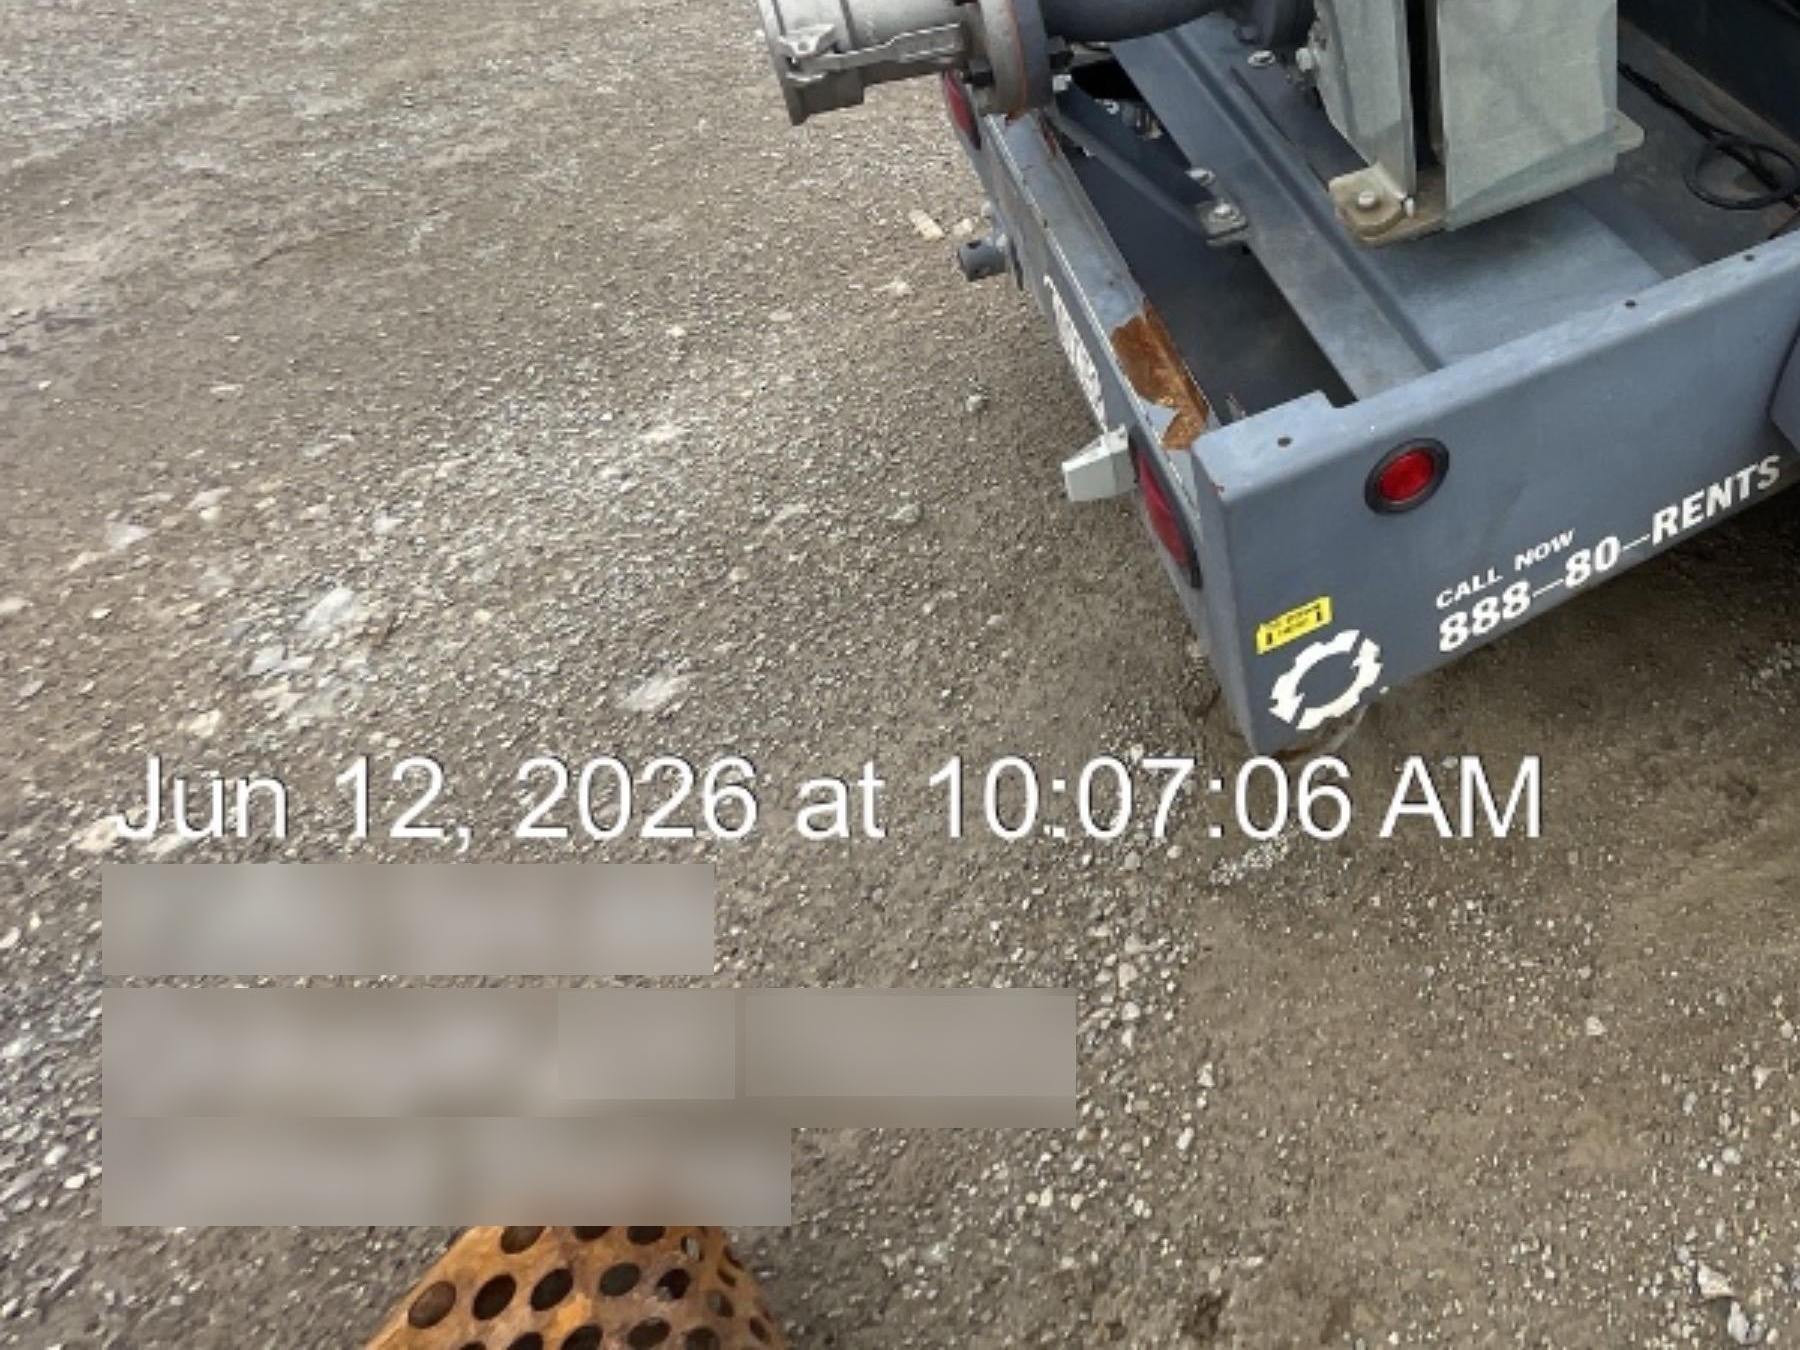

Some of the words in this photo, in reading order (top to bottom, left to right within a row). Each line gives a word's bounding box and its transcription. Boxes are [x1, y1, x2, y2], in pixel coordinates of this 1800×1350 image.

[1436, 568, 1503, 610] CALL
[1514, 528, 1576, 571] NOW
[1438, 454, 1781, 653] 888-80-RENTS
